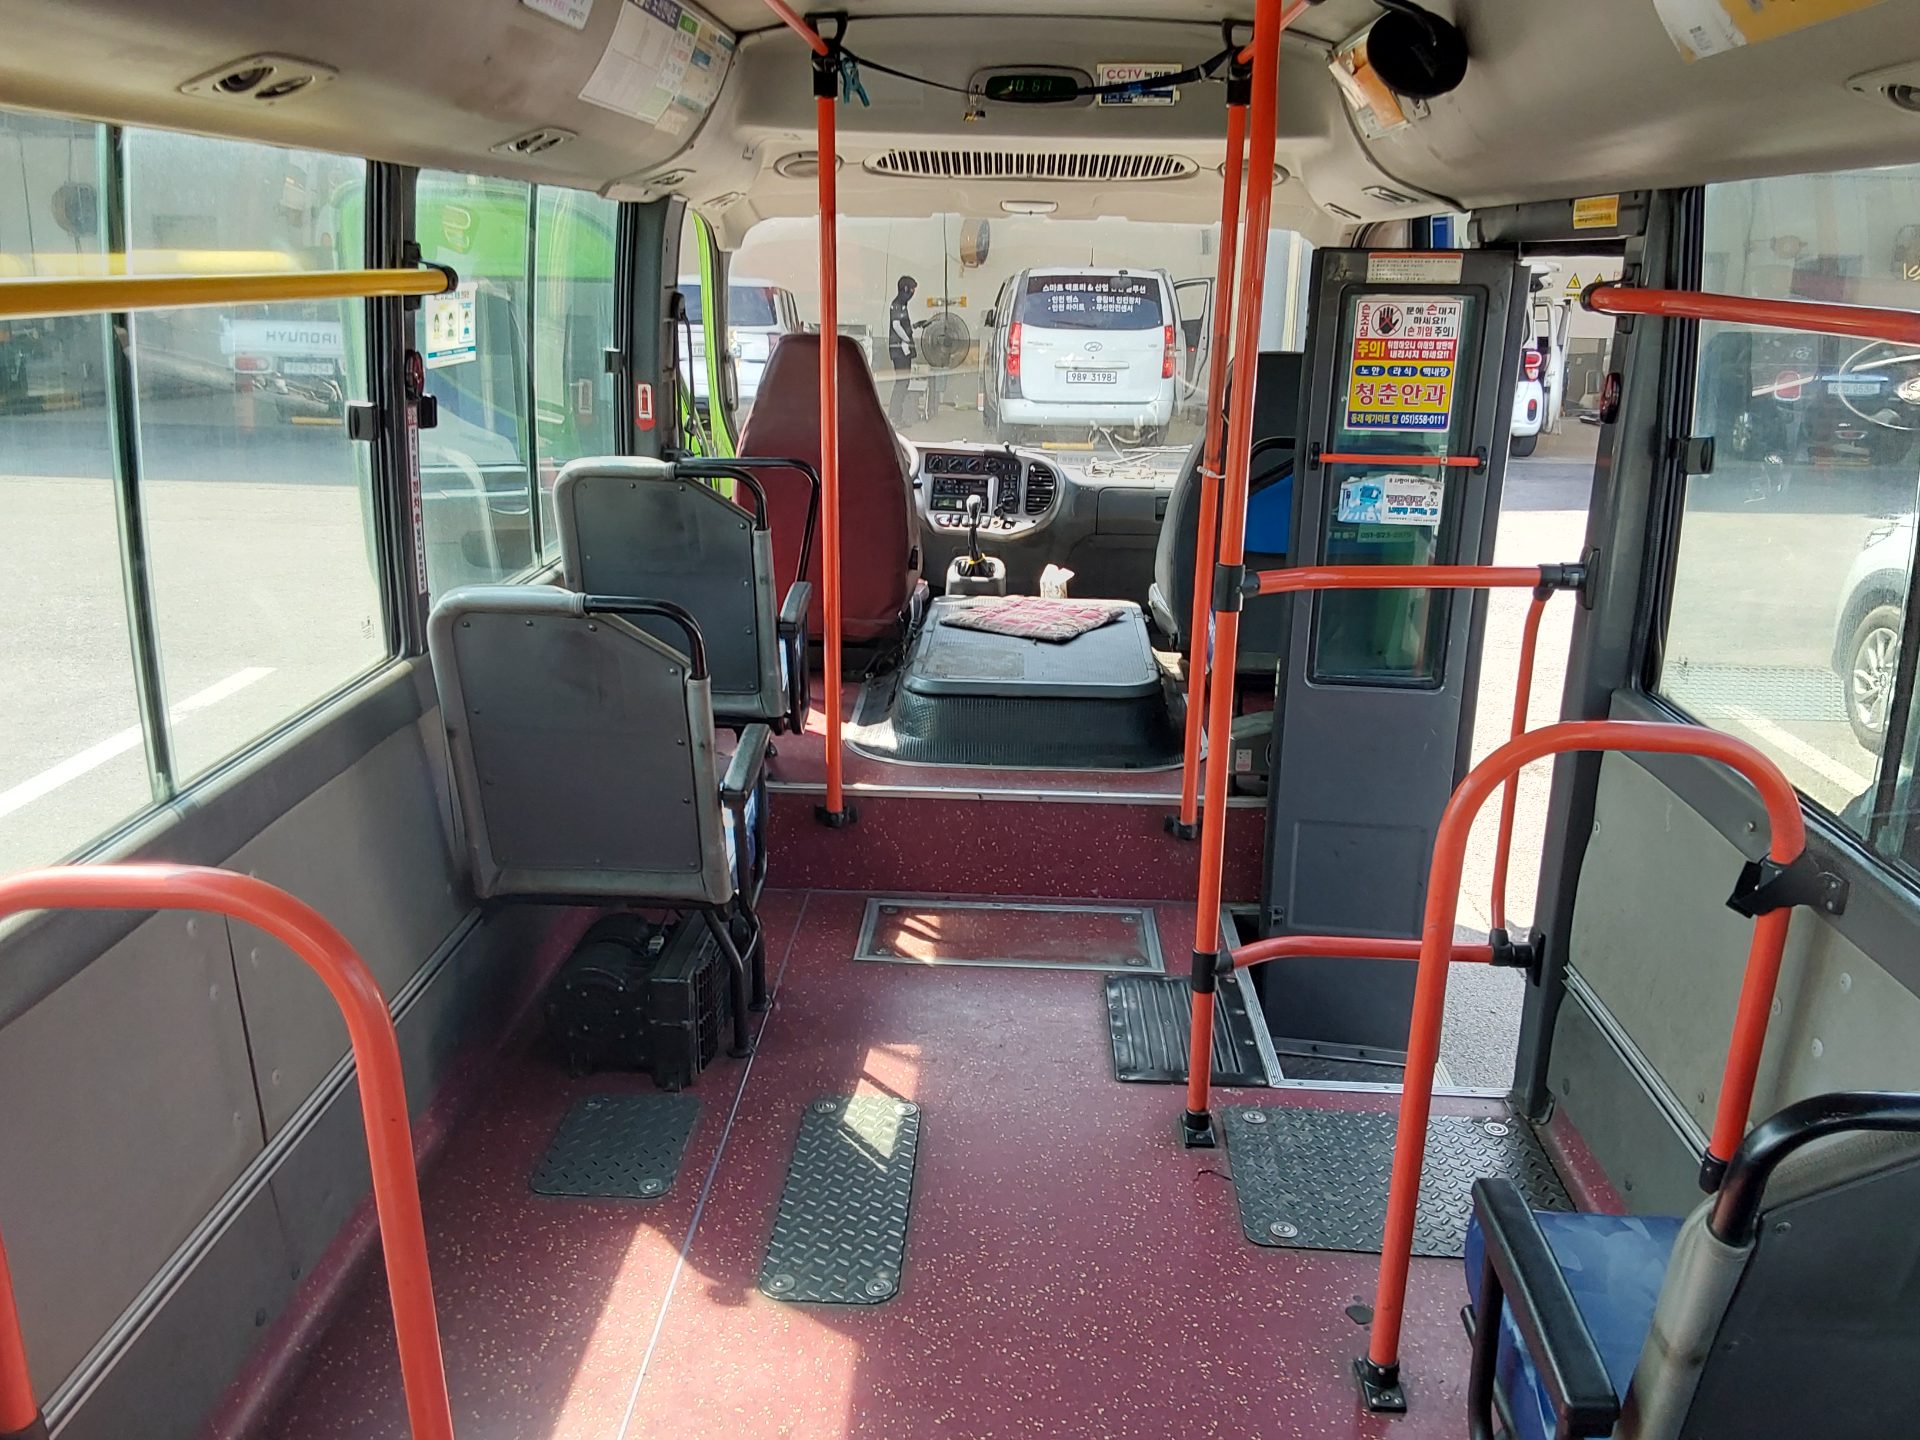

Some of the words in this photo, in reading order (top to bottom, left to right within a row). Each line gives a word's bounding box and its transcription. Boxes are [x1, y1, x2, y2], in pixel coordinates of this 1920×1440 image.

[1107, 69, 1142, 79] CCTV
[1042, 283, 1064, 292] 스마트
[1095, 283, 1109, 292] 산업
[1406, 306, 1424, 315] 문에
[1413, 317, 1446, 325] 마세요!!
[1434, 326, 1454, 337] 주의)
[266, 331, 337, 345] HYUNDAI
[1357, 341, 1386, 358] 주의!
[1422, 367, 1448, 377] 백내장
[1091, 373, 1112, 382] 3198
[1355, 382, 1447, 407] 청춘안과
[1400, 414, 1445, 425] 051)558-0111
